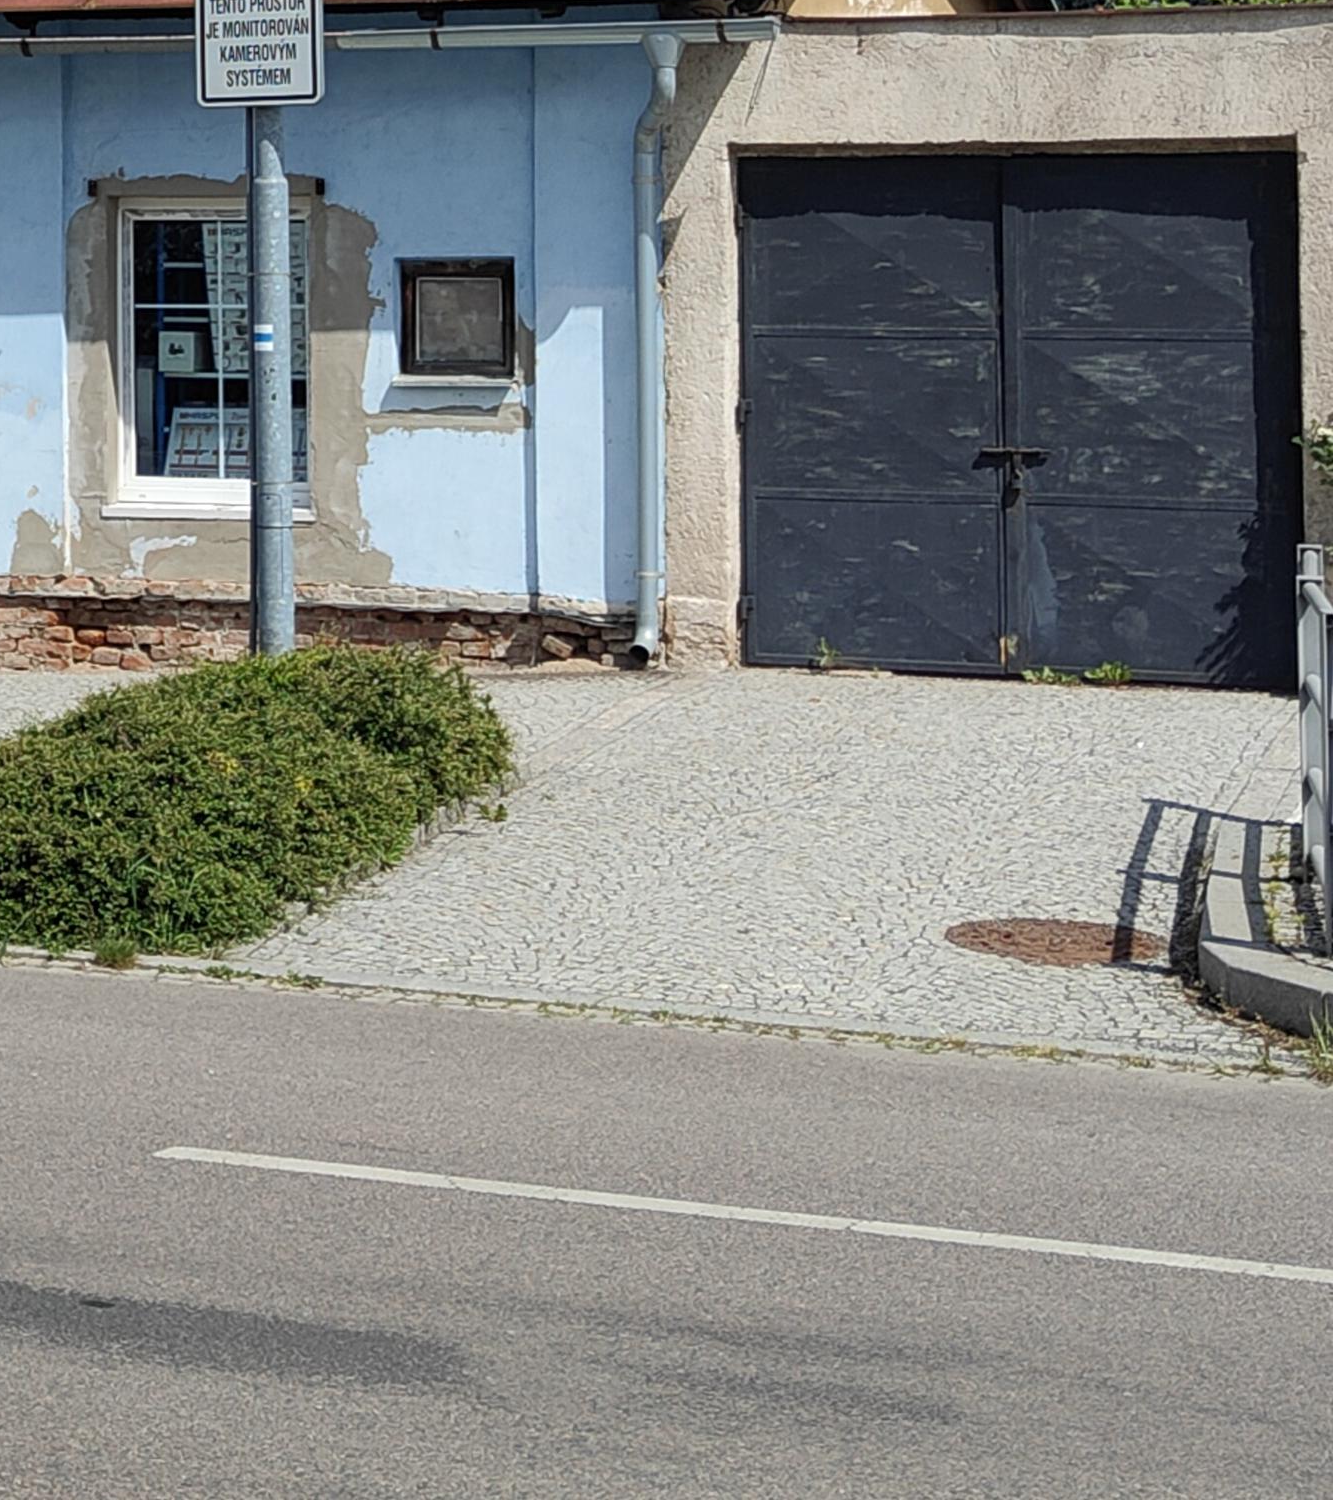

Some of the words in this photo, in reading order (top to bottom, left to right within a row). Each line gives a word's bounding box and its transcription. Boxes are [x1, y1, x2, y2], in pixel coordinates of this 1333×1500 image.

[206, 21, 220, 40] JE
[222, 14, 309, 38] MONITOROVÁN
[219, 38, 297, 62] KAMEROVÝM
[226, 64, 292, 87] SYSTÉMEM
